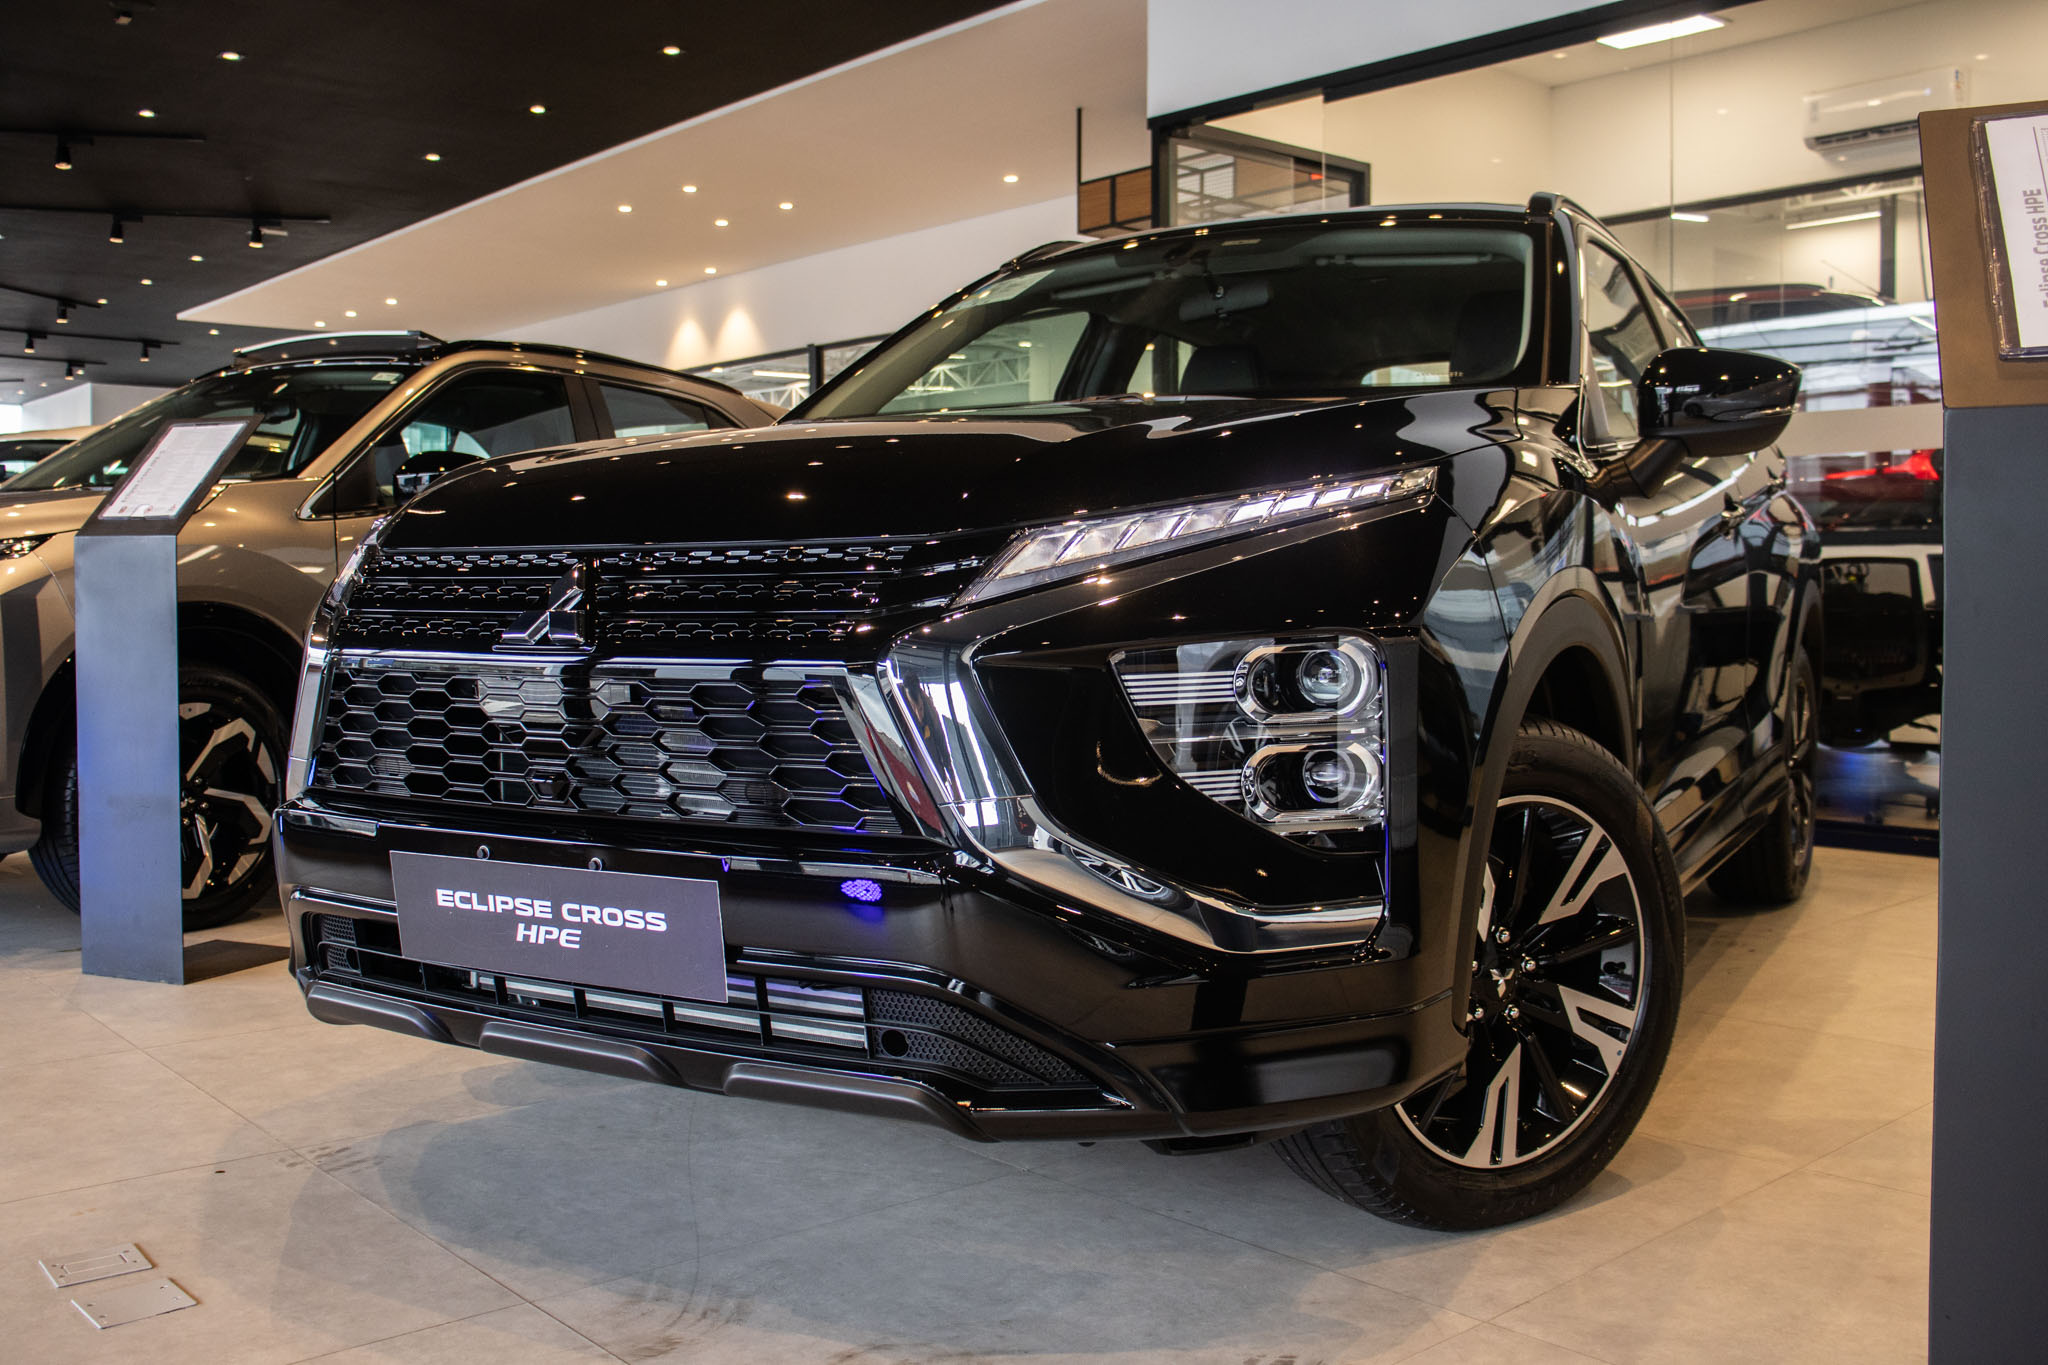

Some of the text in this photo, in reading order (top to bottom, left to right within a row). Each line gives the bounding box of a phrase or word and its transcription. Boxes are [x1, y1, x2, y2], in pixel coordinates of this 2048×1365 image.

[2023, 189, 2048, 308] lise Cross HPE
[436, 889, 668, 932] ECLIPSE CROSS
[516, 923, 582, 949] HPE
